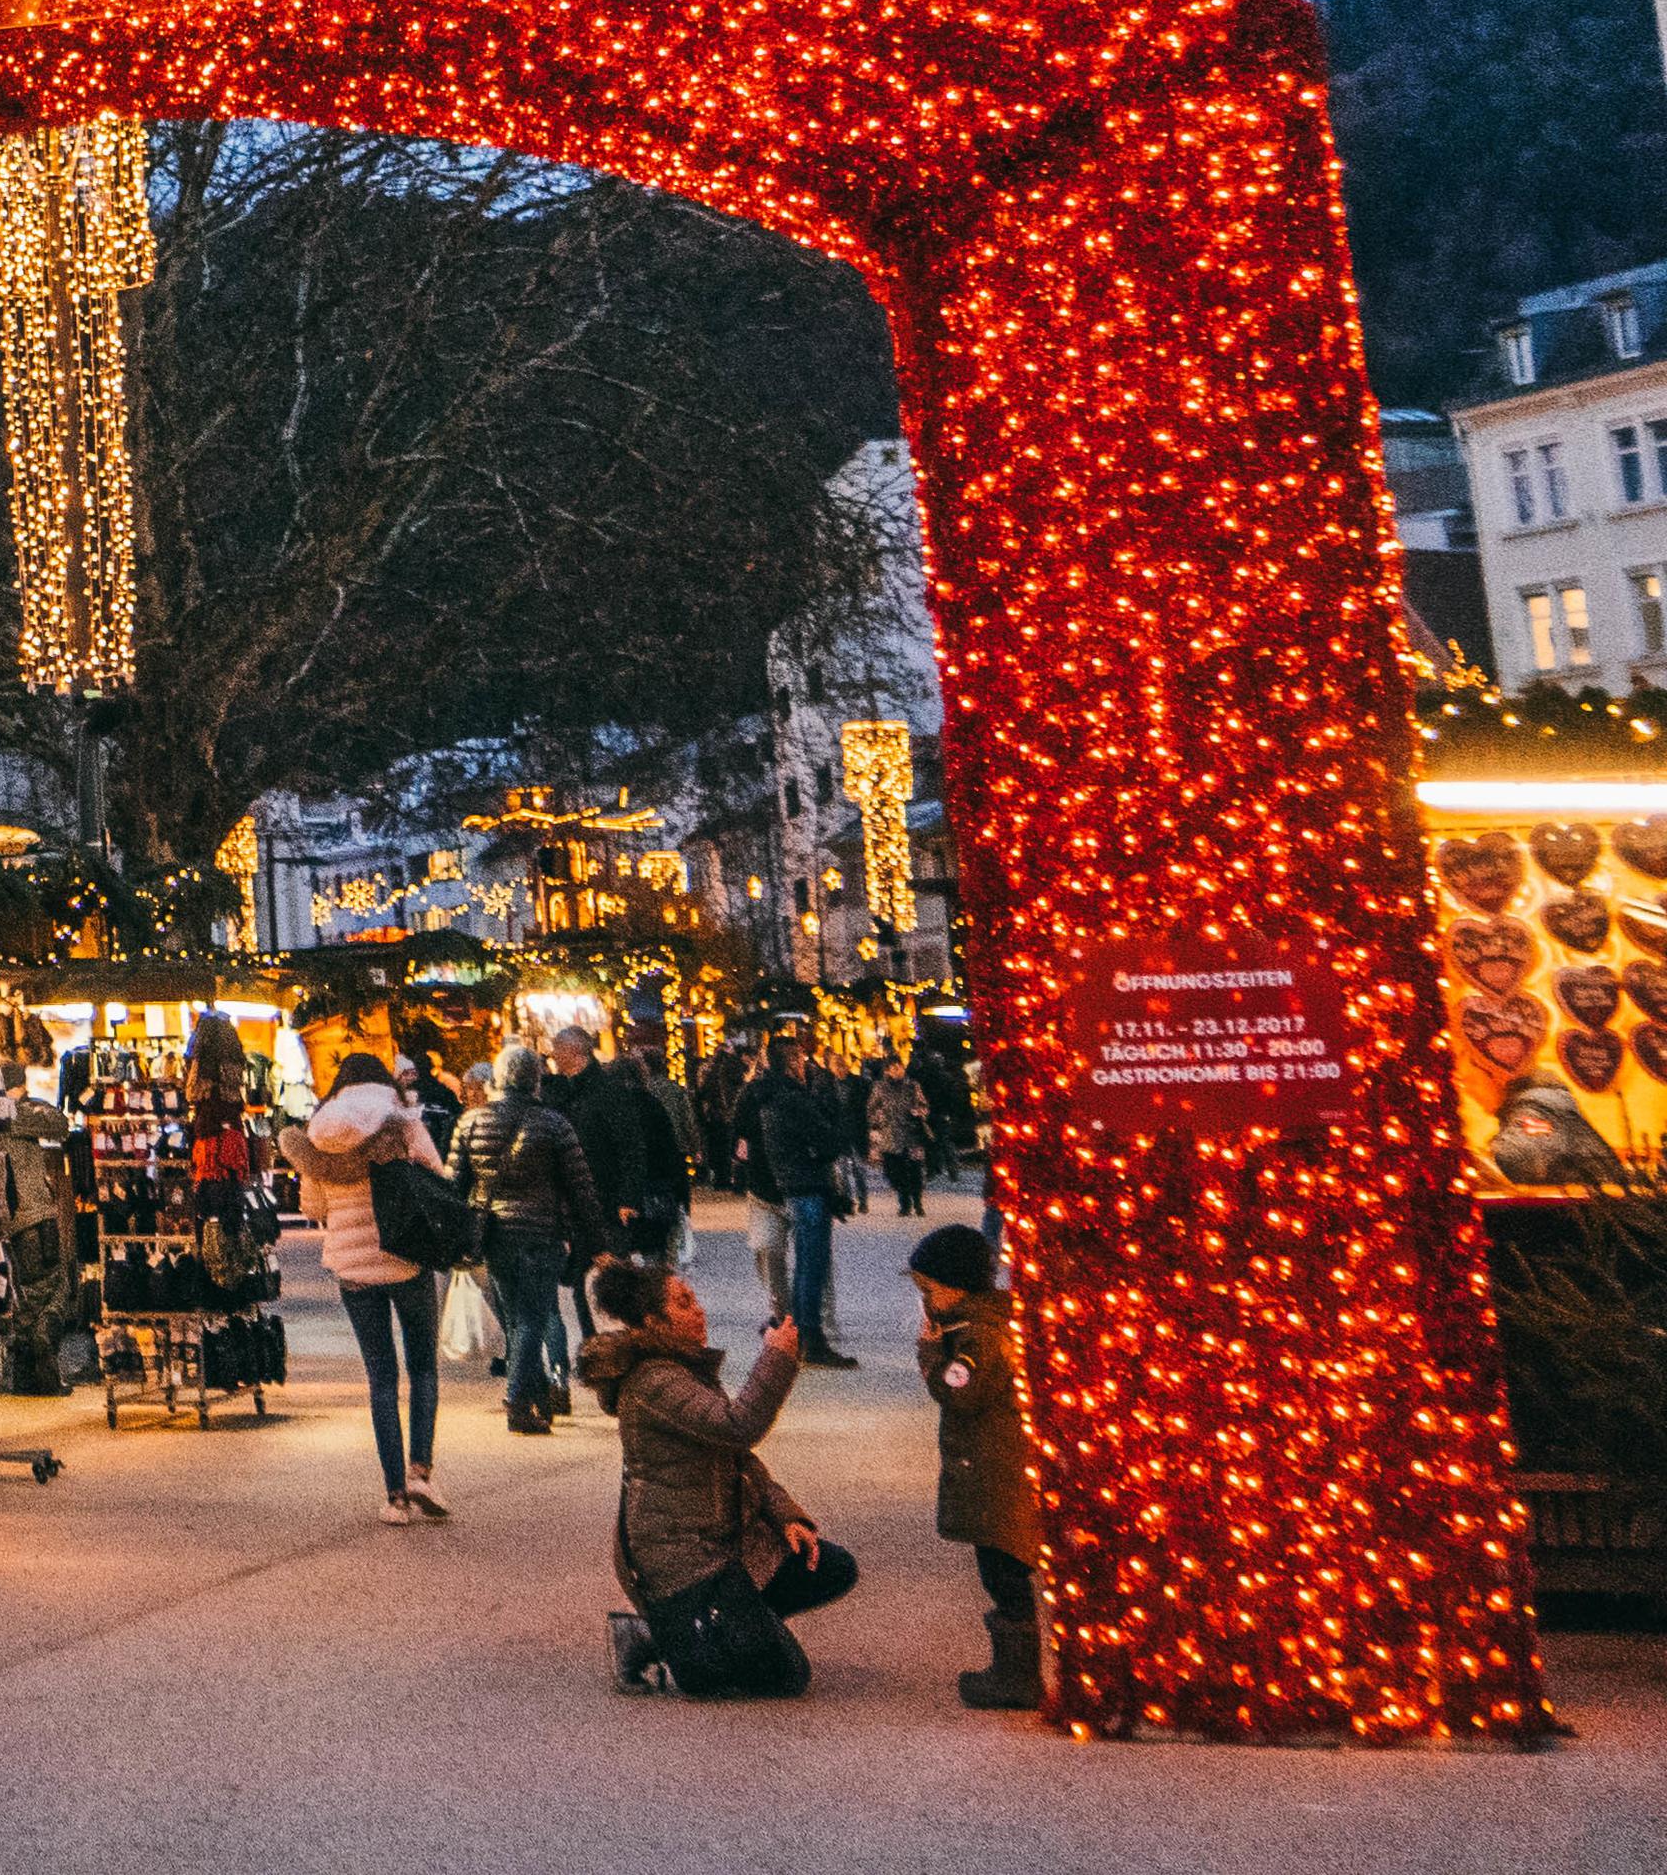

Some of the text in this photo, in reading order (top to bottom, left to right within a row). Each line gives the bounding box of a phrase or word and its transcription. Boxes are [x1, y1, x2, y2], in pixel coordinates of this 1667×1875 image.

[1113, 970, 1292, 992] ÖFFNUNGSZEITEN
[1115, 1020, 1175, 1039] 17.11.
[1192, 1016, 1306, 1037] 23.12.2017
[1100, 1041, 1186, 1063] TÄGLICH
[1192, 1041, 1248, 1059] 11:30
[1268, 1039, 1326, 1058] 20:00
[1091, 1064, 1241, 1086] GASTRONOMIE
[1245, 1063, 1278, 1081] BIS
